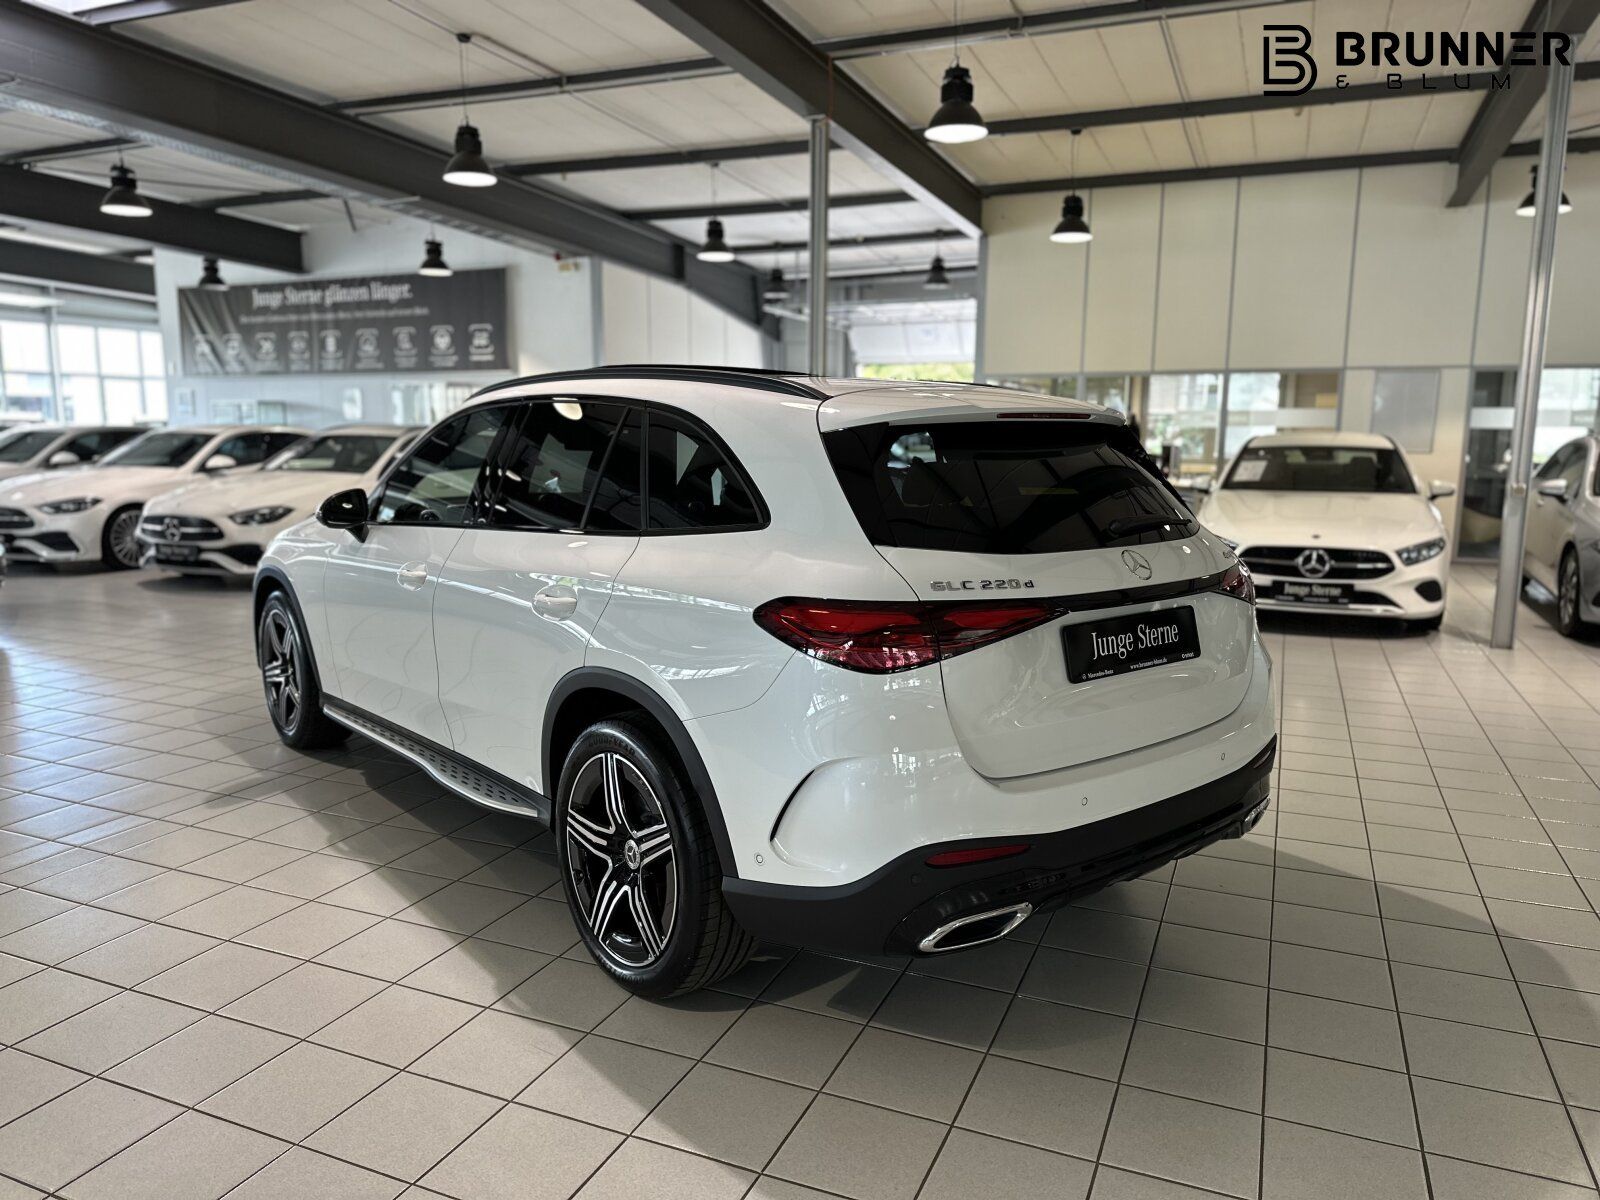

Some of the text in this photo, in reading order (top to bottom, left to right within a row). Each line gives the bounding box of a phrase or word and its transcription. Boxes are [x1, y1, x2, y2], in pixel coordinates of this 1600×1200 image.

[930, 579, 1035, 591] GLC 220 d
[1283, 582, 1342, 597] Junge Sterne
[1091, 623, 1179, 660] Junge Sterne
